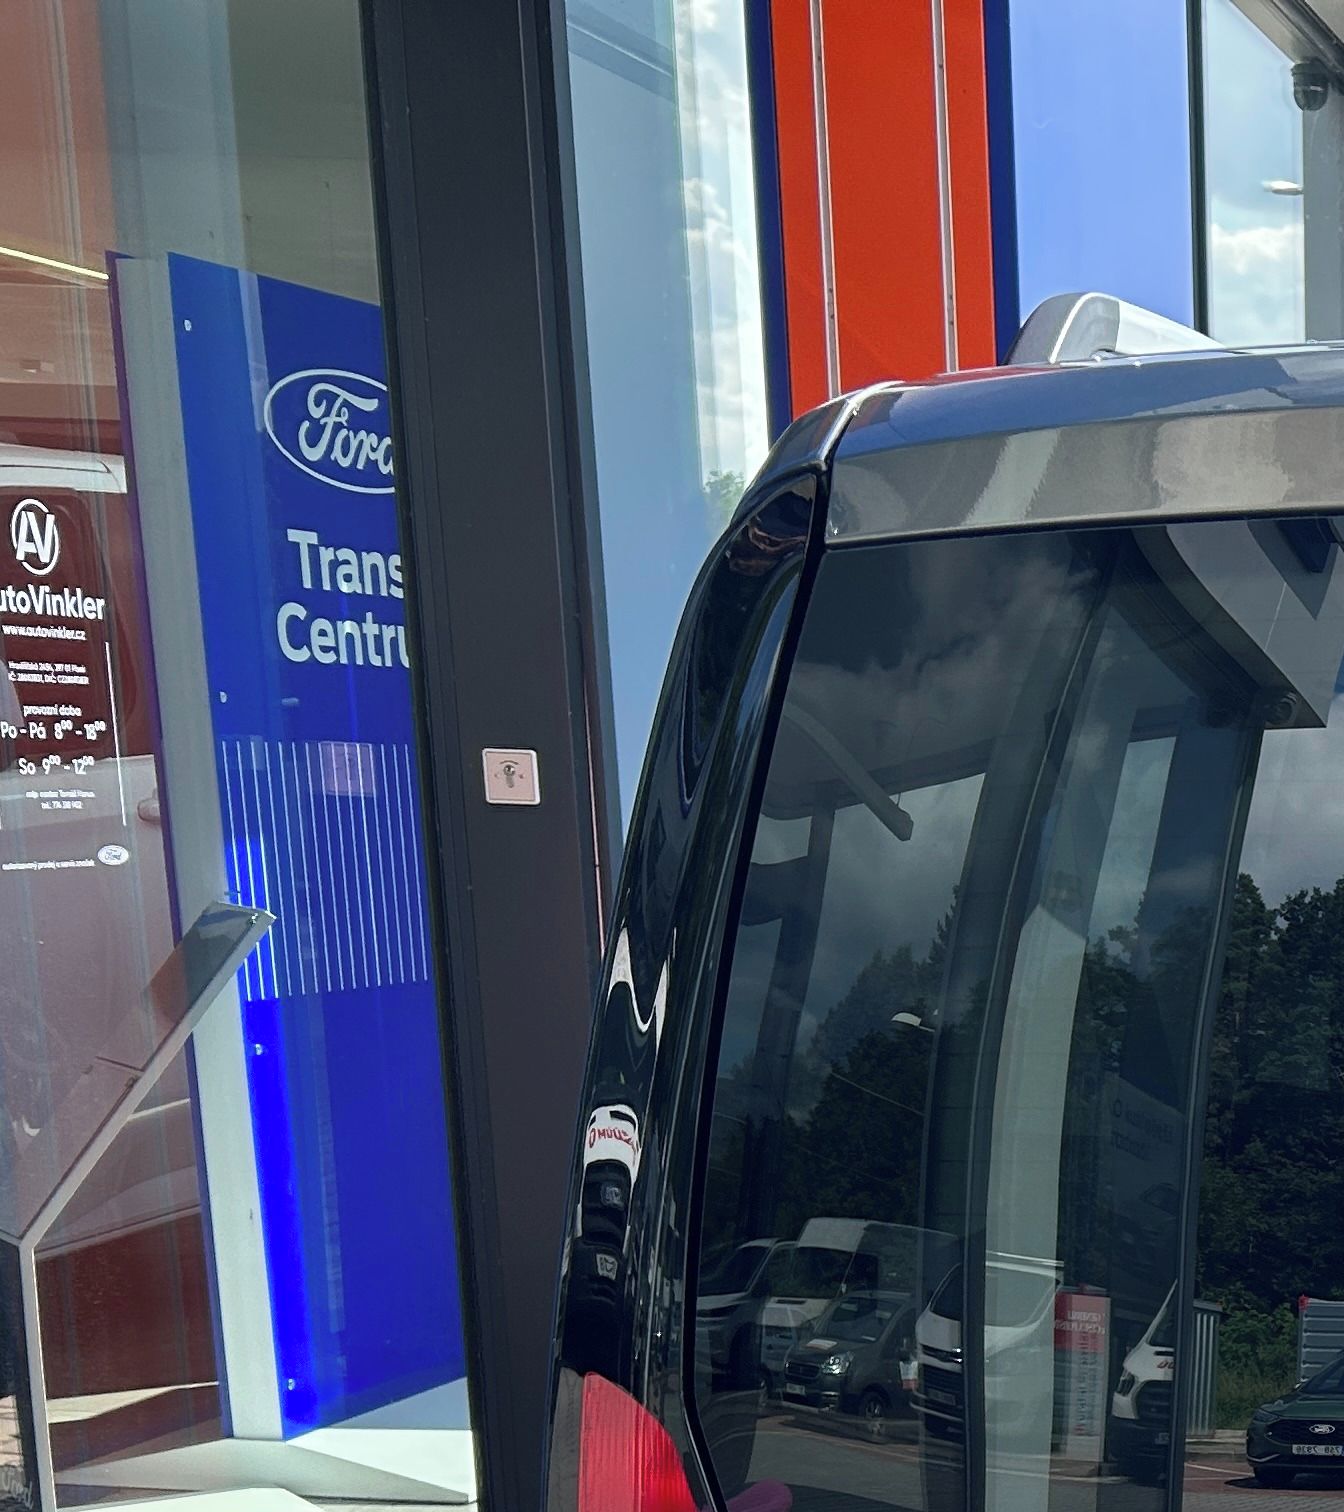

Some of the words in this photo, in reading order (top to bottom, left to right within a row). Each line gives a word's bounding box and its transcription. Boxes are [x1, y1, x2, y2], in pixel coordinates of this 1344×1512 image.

[0, 720, 18, 739] Po
[29, 721, 47, 740] Pá
[18, 757, 37, 776] So
